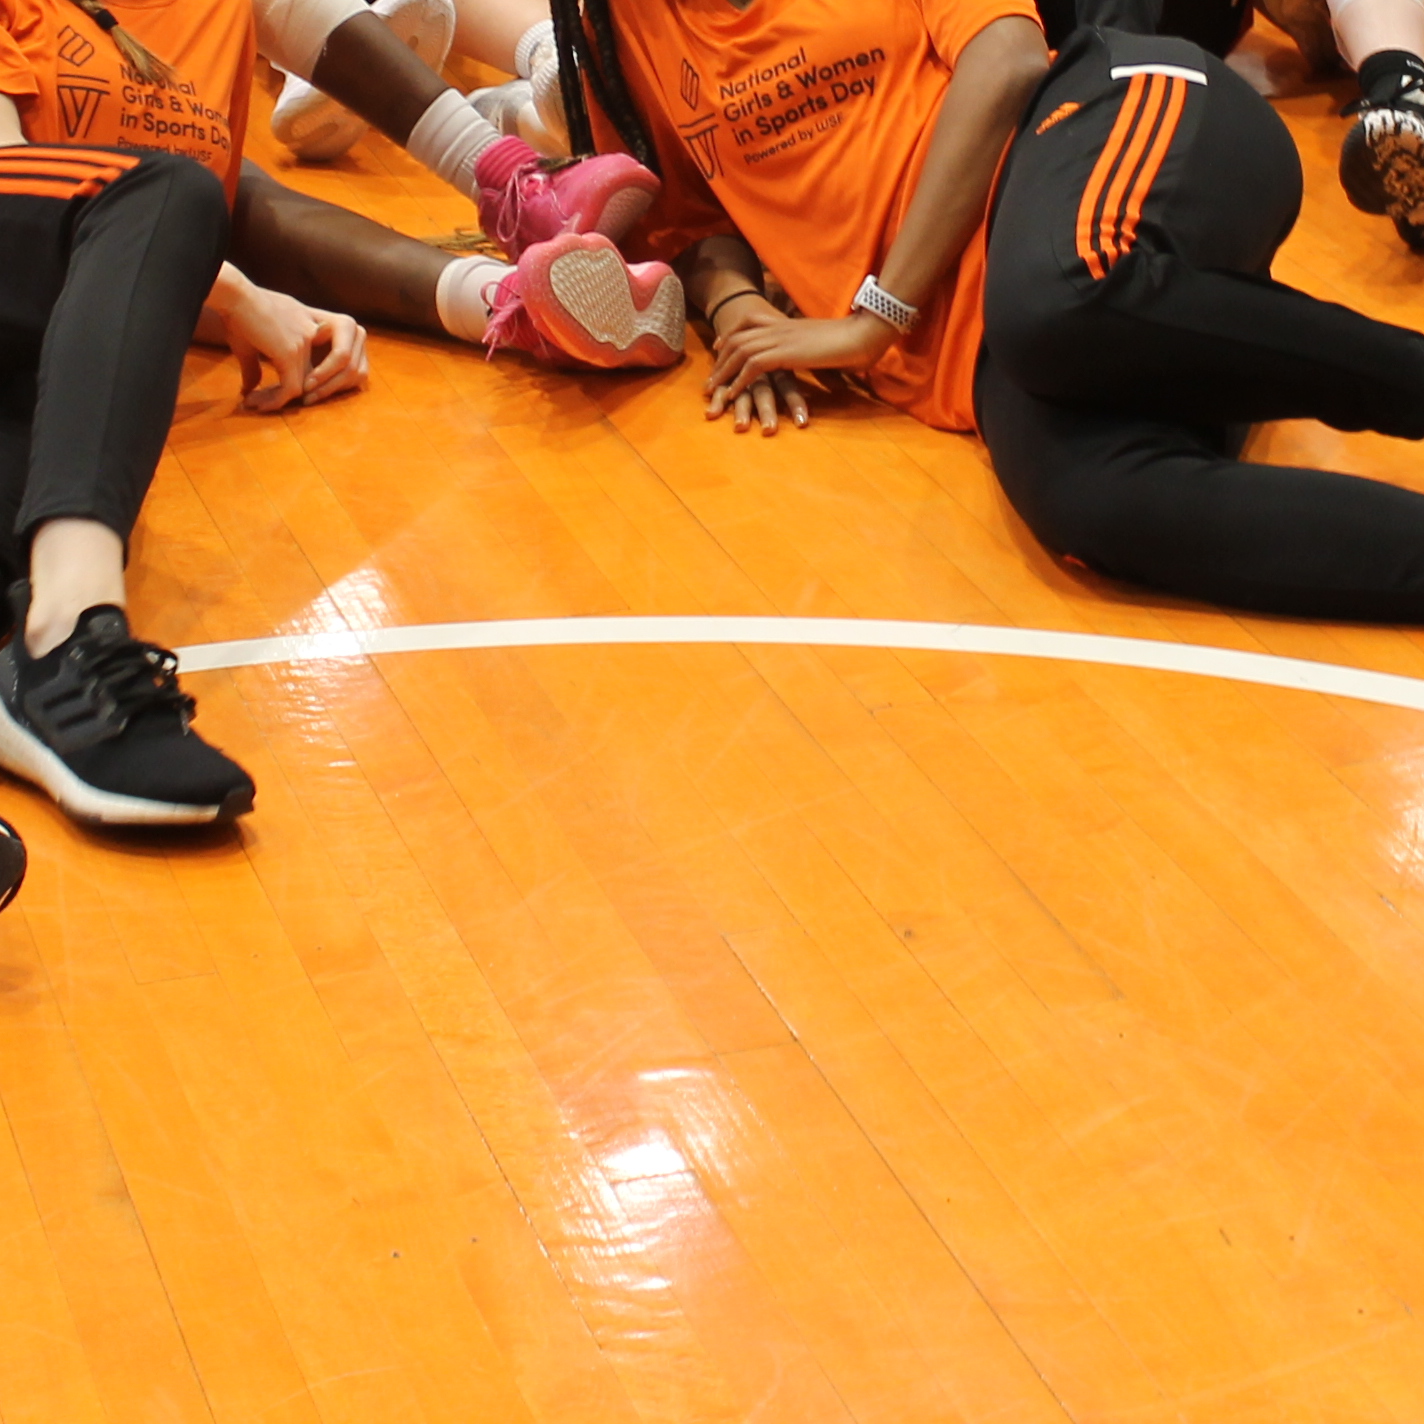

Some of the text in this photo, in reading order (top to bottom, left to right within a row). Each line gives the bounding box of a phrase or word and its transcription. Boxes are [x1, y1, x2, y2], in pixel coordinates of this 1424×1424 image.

[120, 63, 196, 96] Naonal
[719, 46, 807, 100] National
[723, 47, 885, 122] Girls & Women
[122, 85, 230, 127] Girls & Wom
[732, 76, 875, 146] in Sports Day
[120, 107, 230, 150] in Sports Da
[743, 134, 796, 165] Powered
[798, 130, 814, 141] by
